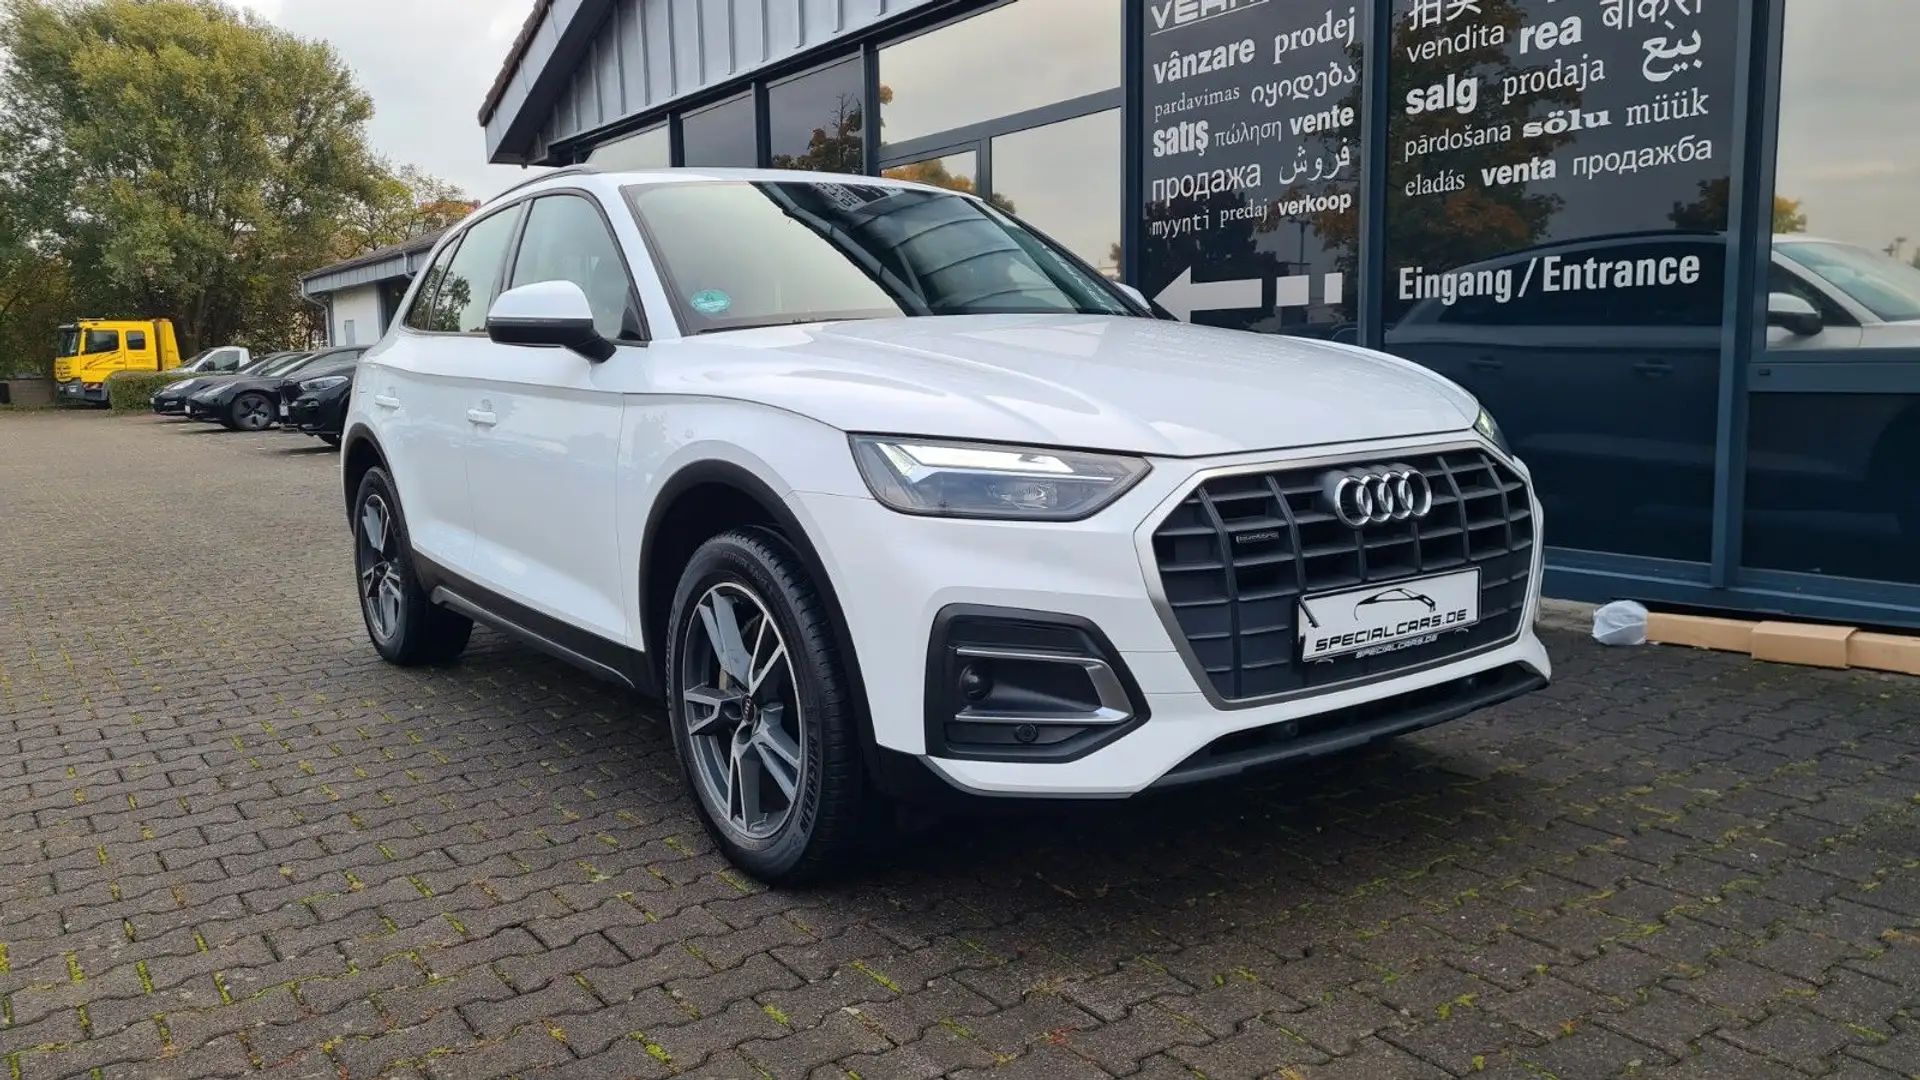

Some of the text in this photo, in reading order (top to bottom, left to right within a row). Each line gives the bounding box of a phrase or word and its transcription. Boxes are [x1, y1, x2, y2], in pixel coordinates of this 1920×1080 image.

[1153, 6, 1355, 84] vânzare prodej
[1406, 13, 1583, 63] vendita rea
[1154, 84, 1240, 124] pardavimas
[1405, 53, 1606, 115] salg prodaja
[1153, 119, 1209, 157] satış
[1214, 120, 1282, 147] πώληση
[1289, 104, 1355, 136] vente
[1405, 87, 1709, 163] pārdošana sölu müük
[1405, 156, 1557, 197] eladás venta
[1572, 134, 1712, 180] продажба
[1152, 162, 1262, 207] продажа
[1151, 192, 1352, 239] myynti predaj verkoop
[1315, 608, 1467, 652] SPECIALCARS.DE
